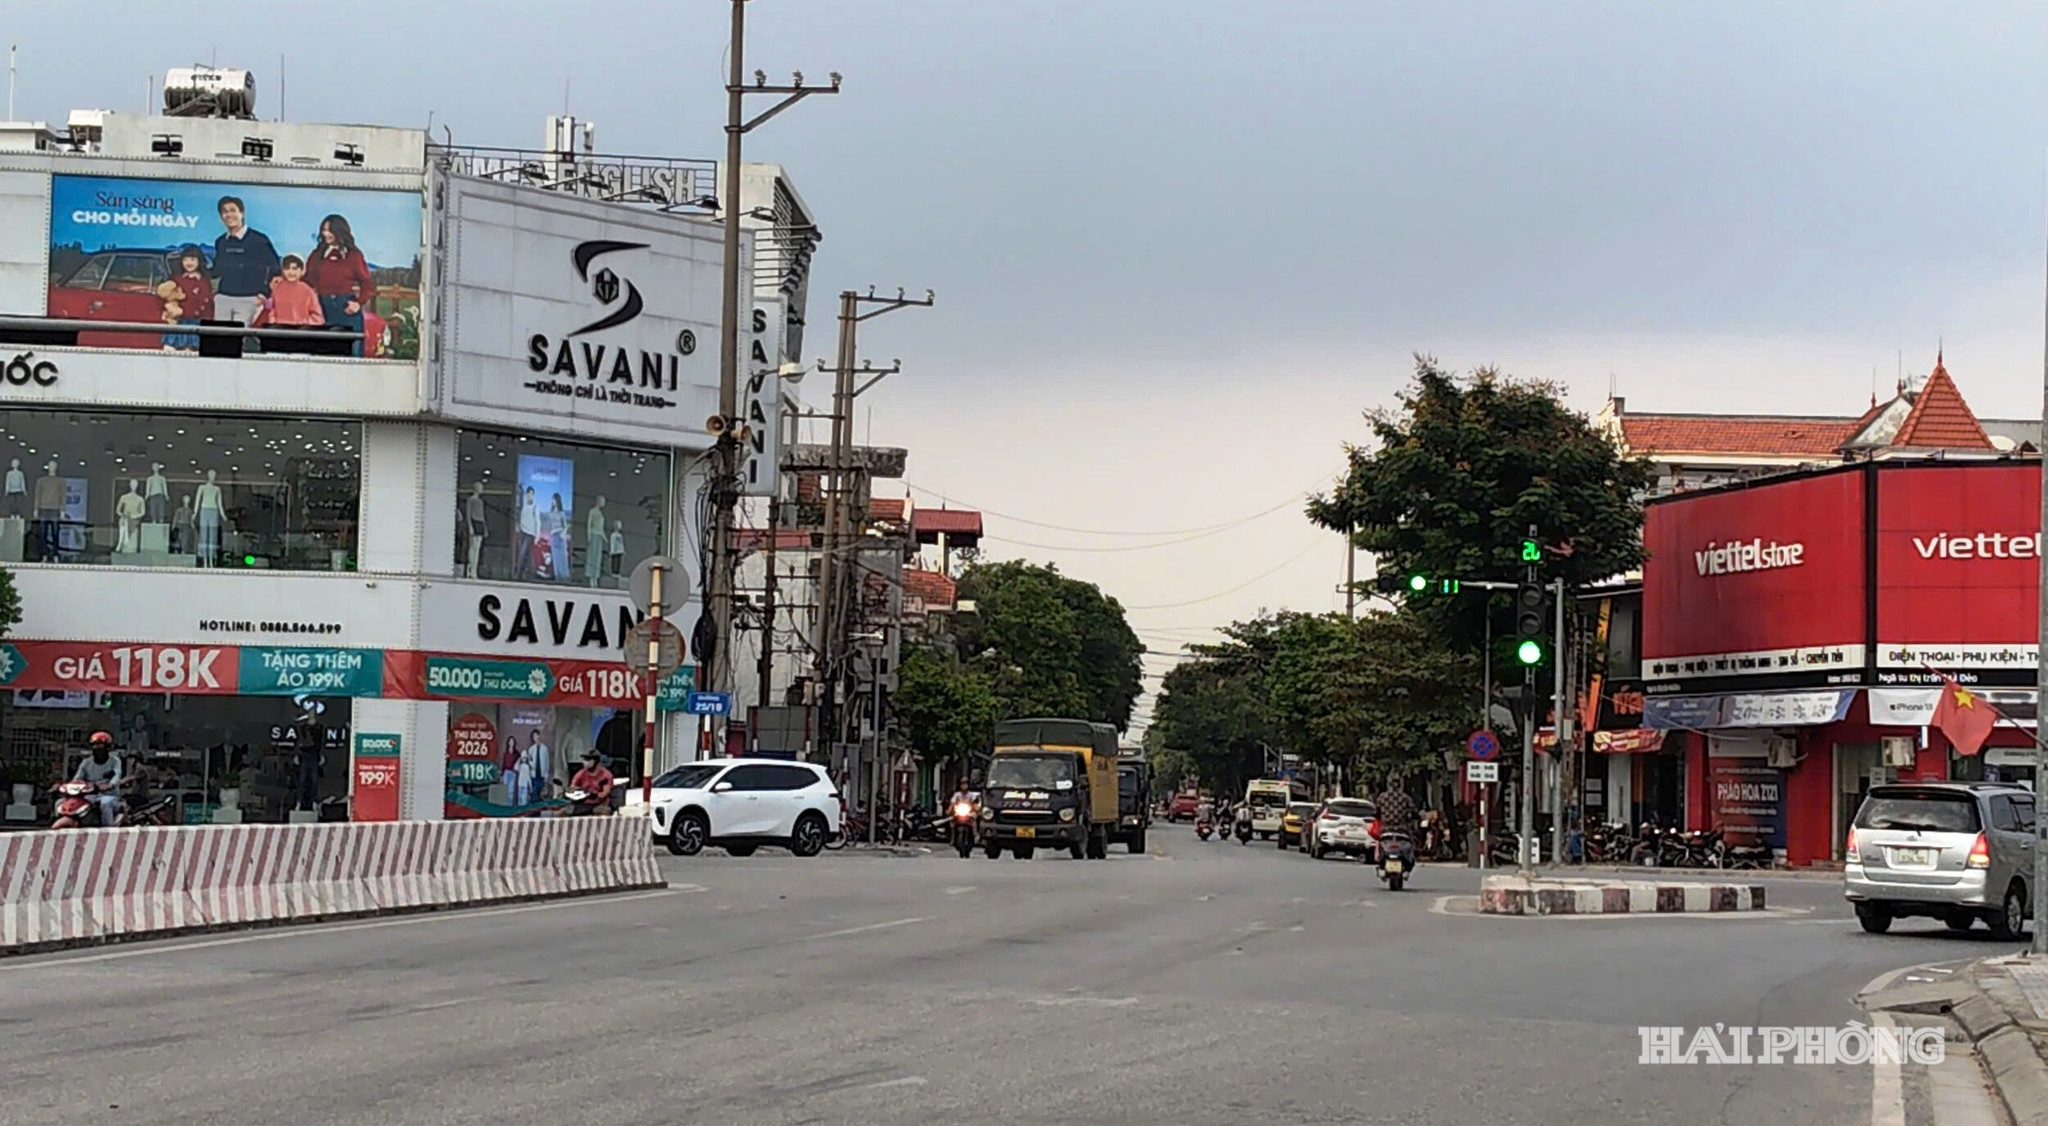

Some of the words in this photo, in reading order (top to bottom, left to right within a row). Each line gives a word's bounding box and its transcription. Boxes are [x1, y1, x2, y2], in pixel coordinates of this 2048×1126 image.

[556, 162, 697, 206] ENGLISH
[72, 210, 111, 225] CHO
[150, 213, 199, 229] NGÀY
[529, 333, 679, 392] SAVANI
[750, 308, 768, 484] SAVANI
[262, 650, 311, 671] TẶNG
[315, 652, 362, 669] THÊM
[1889, 649, 1916, 665] ĐIỆN
[1919, 651, 1955, 664] THOẠI
[1962, 651, 1987, 664] PHỤ
[1990, 649, 2018, 665] KIỆN
[53, 652, 106, 680] GIÁ
[113, 647, 221, 688] 118K
[276, 671, 304, 687] ÁO
[308, 673, 346, 688] 199K
[429, 667, 482, 689] 50.000
[559, 672, 583, 693] GIÁ
[587, 669, 641, 699] 118K
[457, 741, 488, 755] 2026
[358, 771, 396, 785] 199K
[462, 763, 493, 780] 118K
